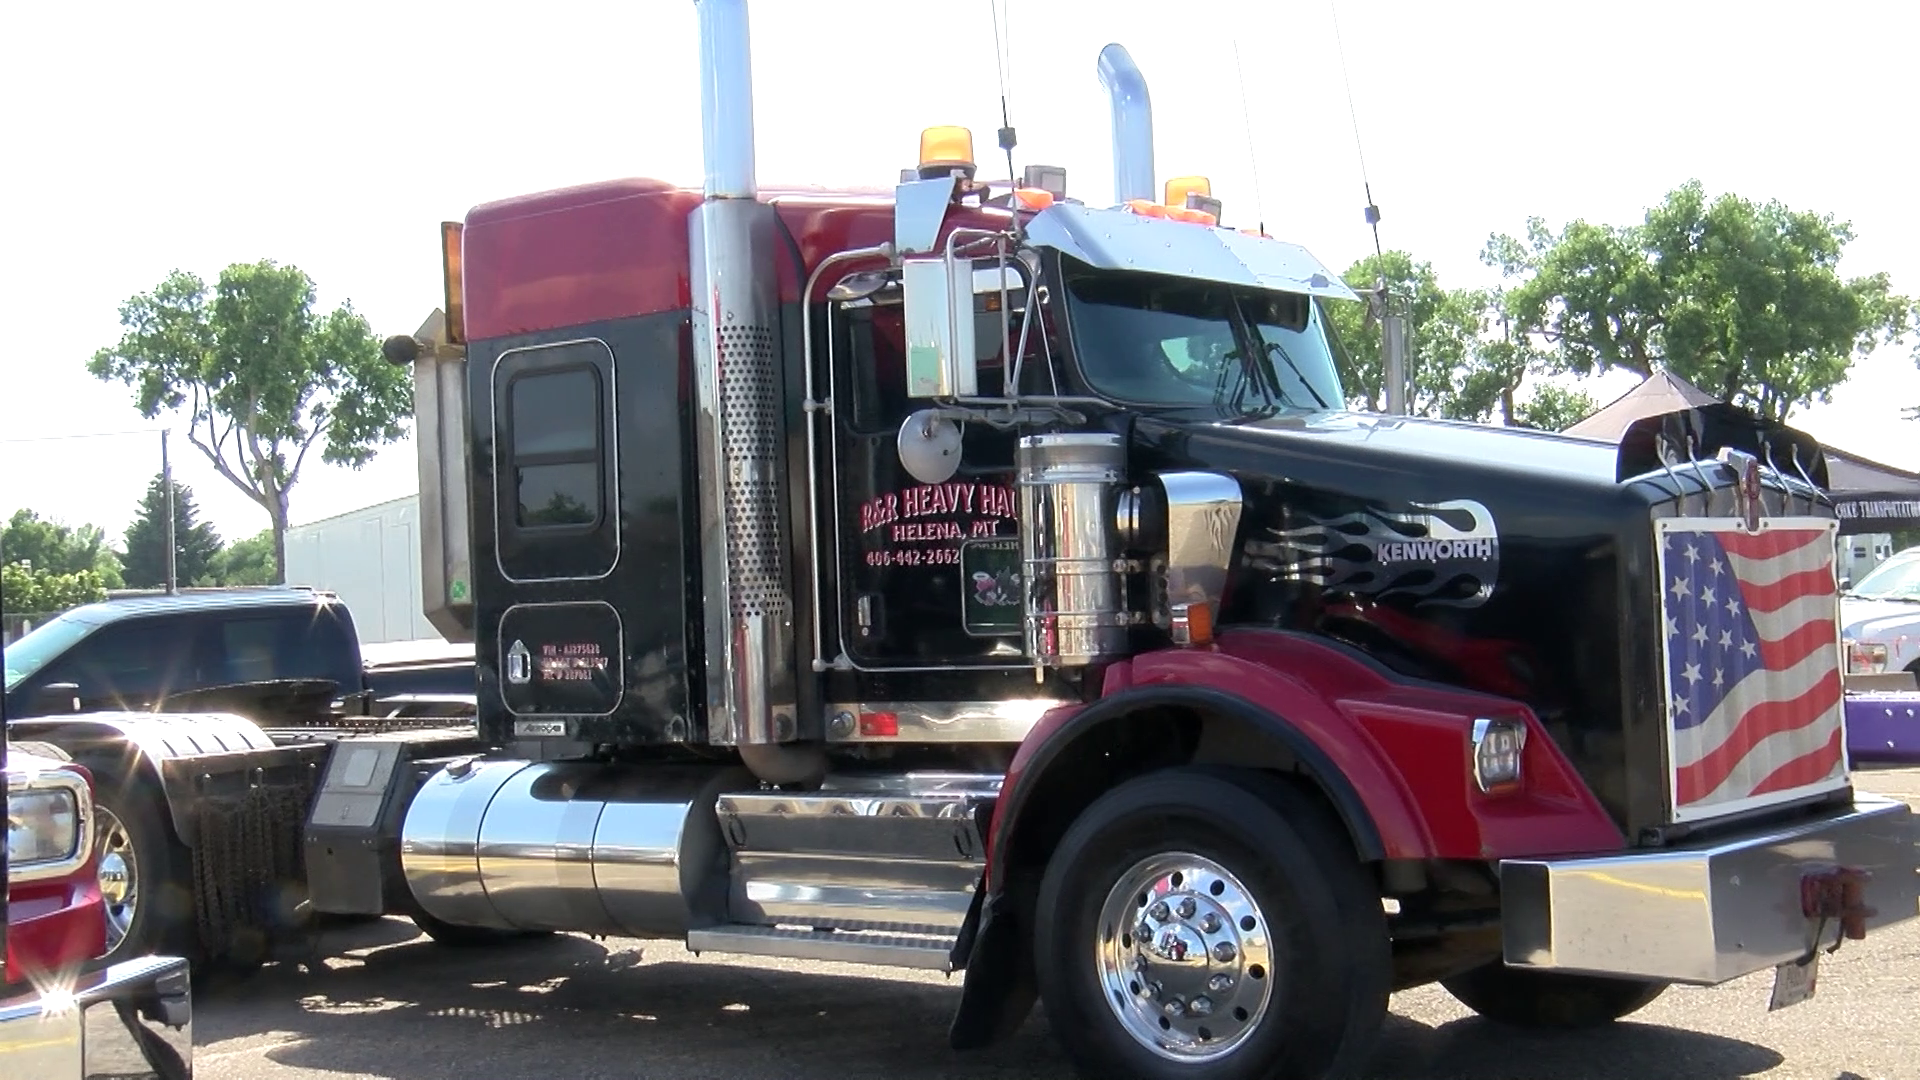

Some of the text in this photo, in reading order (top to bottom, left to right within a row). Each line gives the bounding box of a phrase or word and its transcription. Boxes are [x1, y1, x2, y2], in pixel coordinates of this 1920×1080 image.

[860, 493, 899, 533] R&R
[903, 483, 975, 518] HEAVY
[892, 519, 1000, 542] HELENA, MT
[866, 549, 961, 566] 406-442-2662
[1377, 538, 1492, 562] KENWORTH
